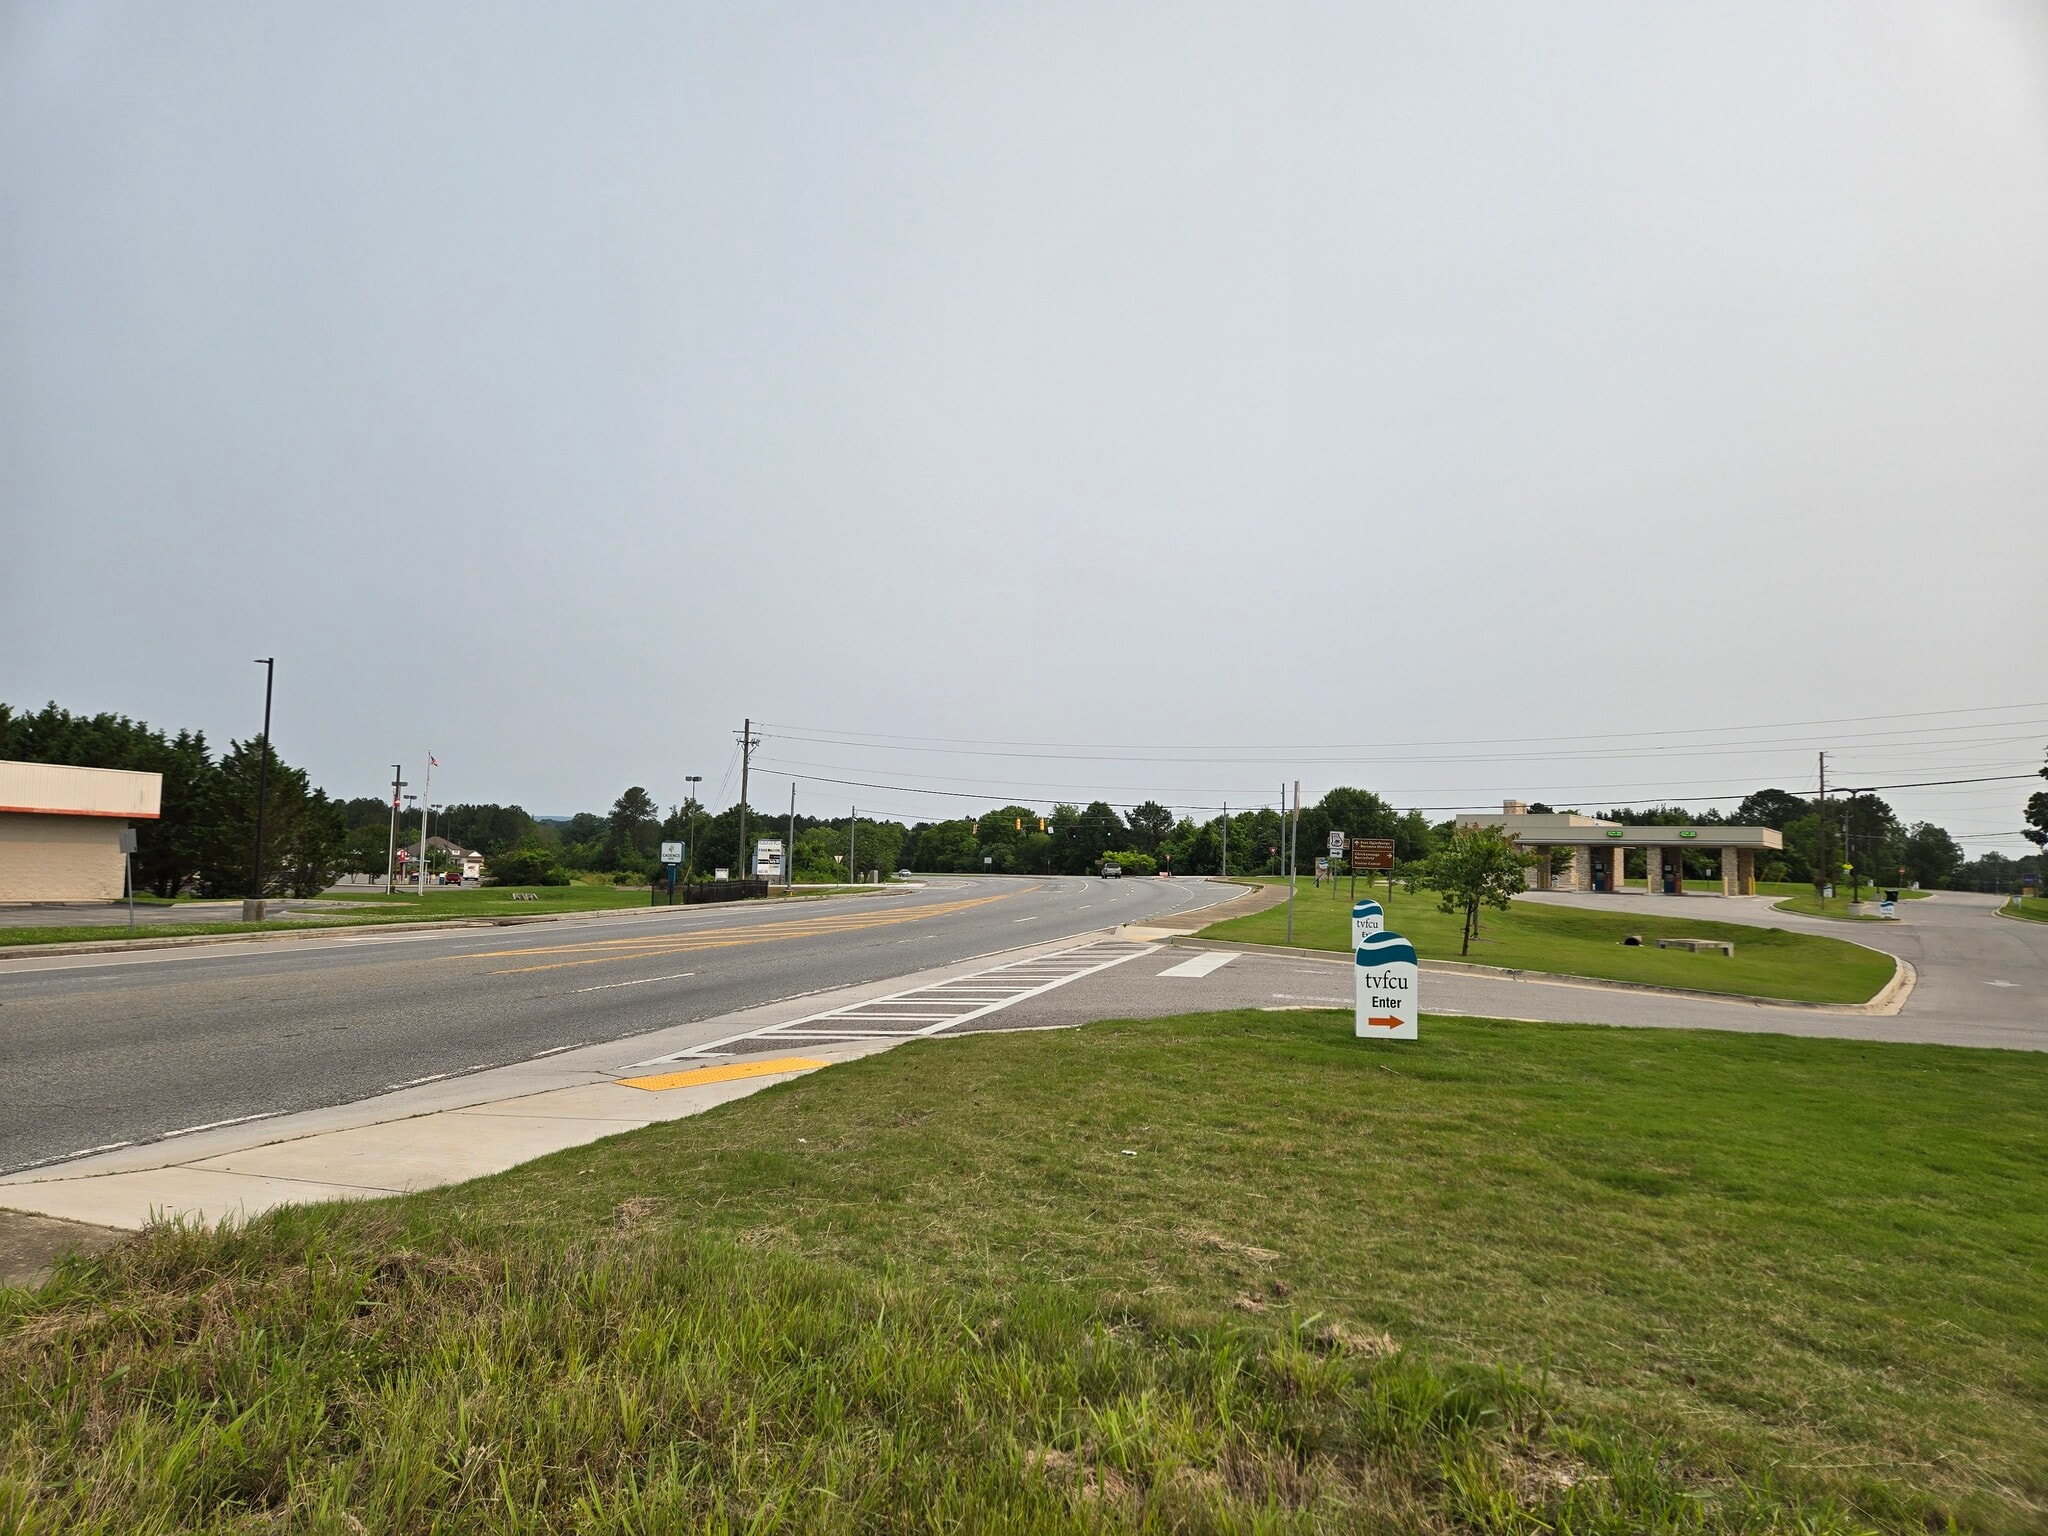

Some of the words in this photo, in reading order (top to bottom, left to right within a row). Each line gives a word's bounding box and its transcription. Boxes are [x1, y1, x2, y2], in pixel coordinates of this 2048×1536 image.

[1357, 918, 1378, 929] tvfcu
[1365, 970, 1409, 990] tvfcu
[1372, 996, 1402, 1008] Enter
